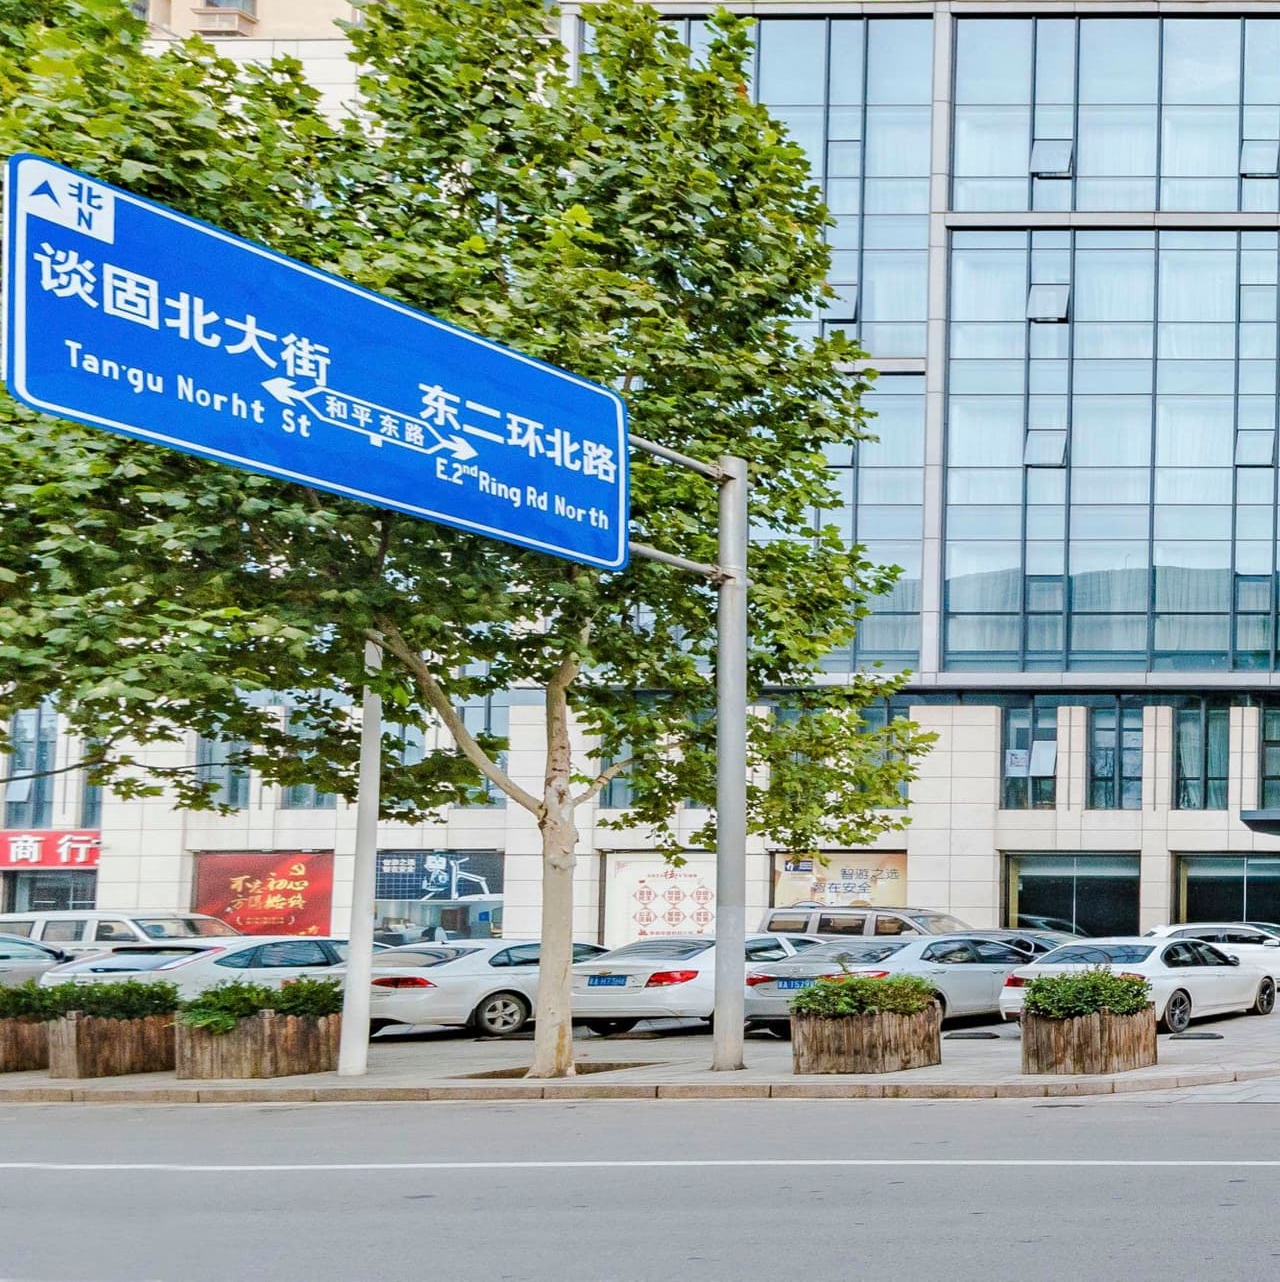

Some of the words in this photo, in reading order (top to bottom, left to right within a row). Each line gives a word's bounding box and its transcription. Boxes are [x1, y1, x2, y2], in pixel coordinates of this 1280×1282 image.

[68, 182, 103, 210] 北
[77, 207, 93, 231] N
[33, 242, 332, 386] 谈固北大街
[176, 374, 265, 423] Norht
[281, 408, 311, 438] St
[325, 395, 425, 447] 和平东路
[418, 382, 618, 484] 东二环北路
[479, 470, 522, 507] Ring
[526, 485, 548, 511] Rd
[555, 494, 609, 530] North
